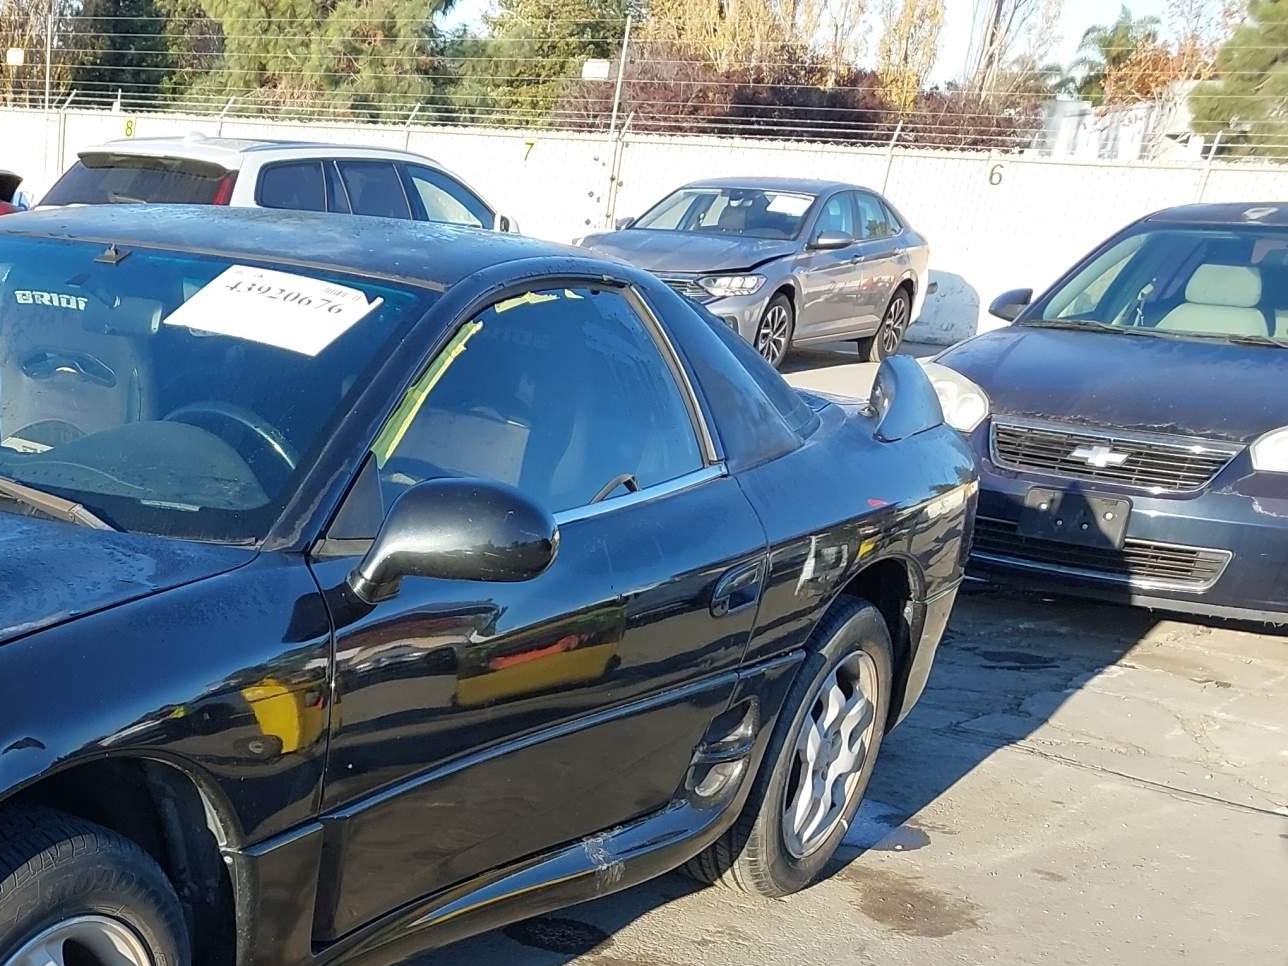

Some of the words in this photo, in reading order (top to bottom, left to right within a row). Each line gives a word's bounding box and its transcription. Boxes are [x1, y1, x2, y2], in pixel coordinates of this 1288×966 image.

[125, 120, 133, 137] 8
[524, 142, 535, 161] 7
[989, 164, 1004, 186] 6
[225, 281, 345, 314] 43920676
